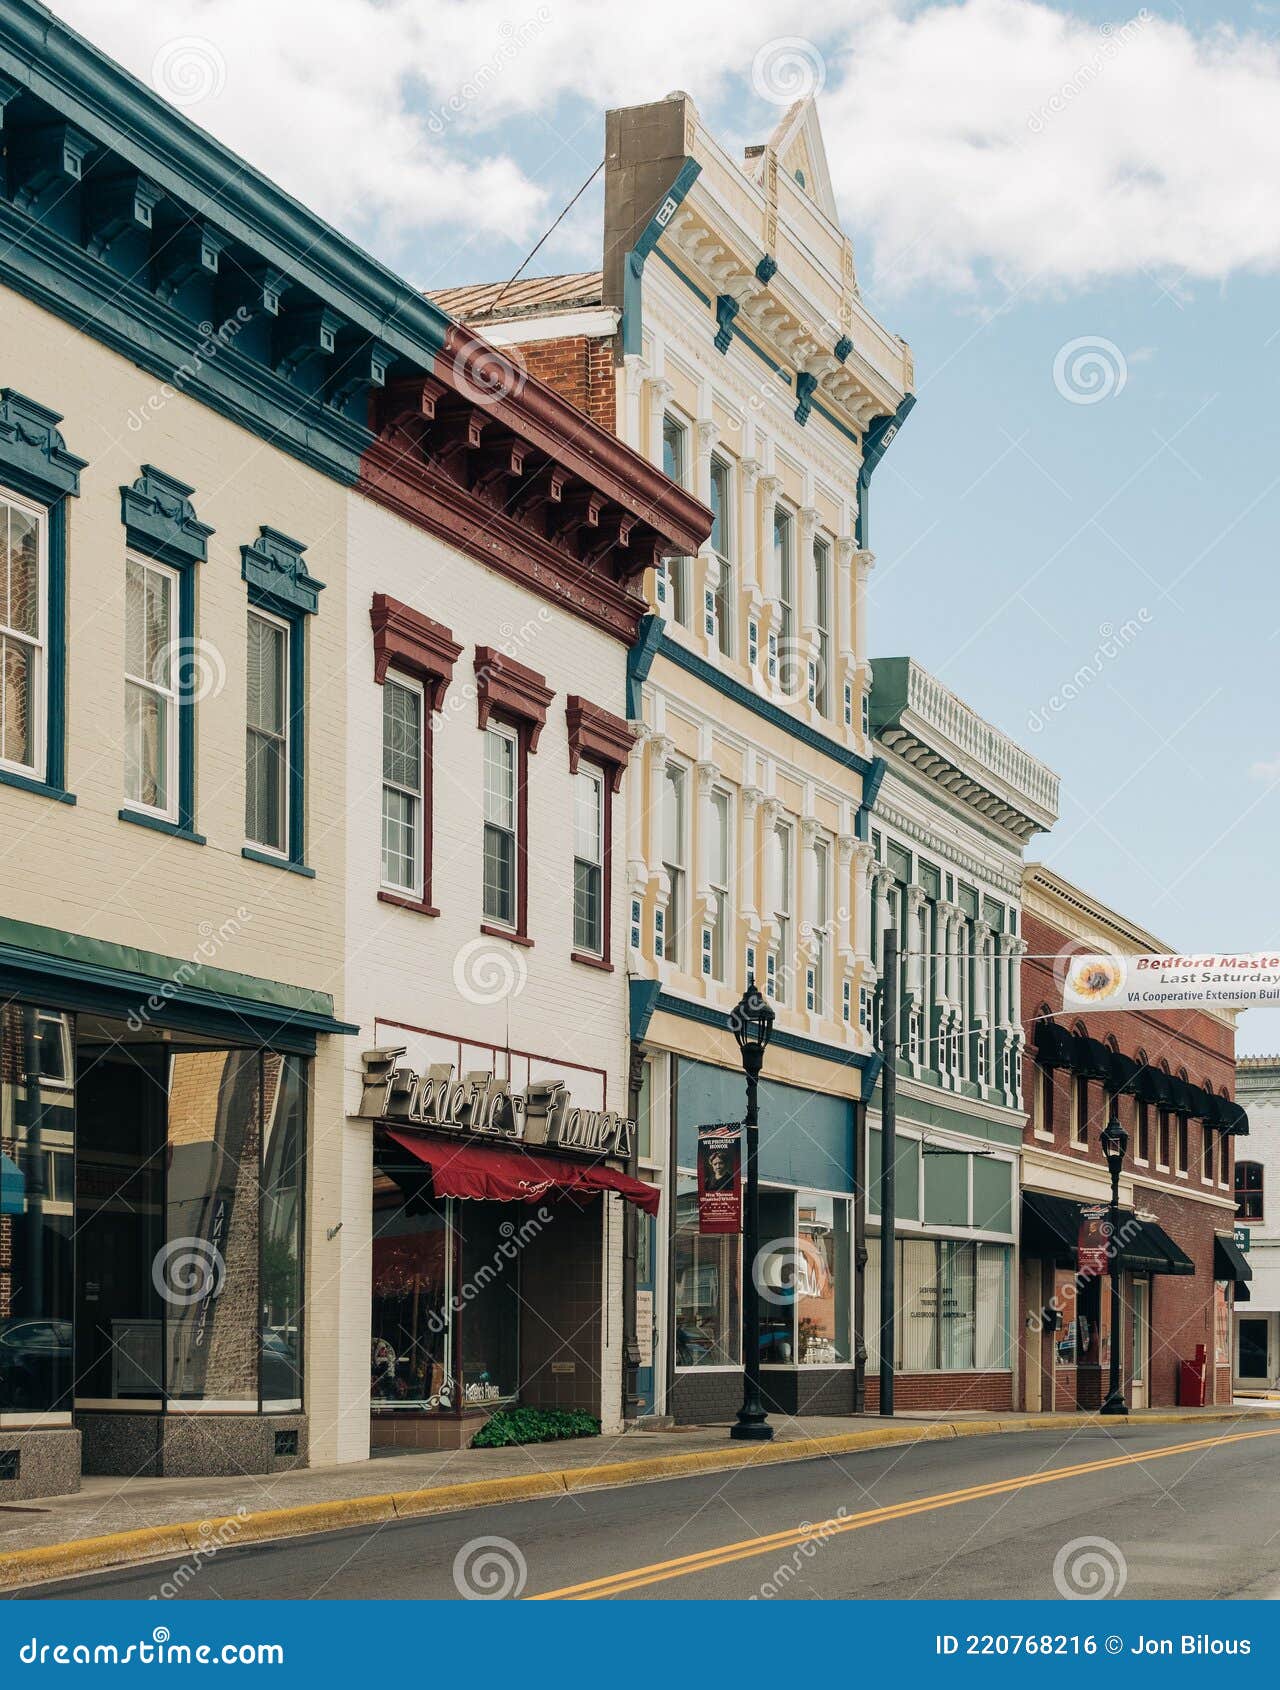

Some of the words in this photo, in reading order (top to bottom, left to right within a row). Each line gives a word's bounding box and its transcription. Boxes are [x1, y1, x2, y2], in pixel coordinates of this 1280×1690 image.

[1136, 957, 1216, 970] Bedford
[1219, 957, 1280, 969] Maste
[1160, 972, 1197, 984] Last
[1201, 972, 1280, 985] Saturday
[1128, 992, 1140, 1002] VA
[1143, 991, 1203, 1004] Cooperative
[1206, 990, 1256, 1001] Extension
[1259, 989, 1280, 999] Buil
[528, 1079, 636, 1158] Flowers
